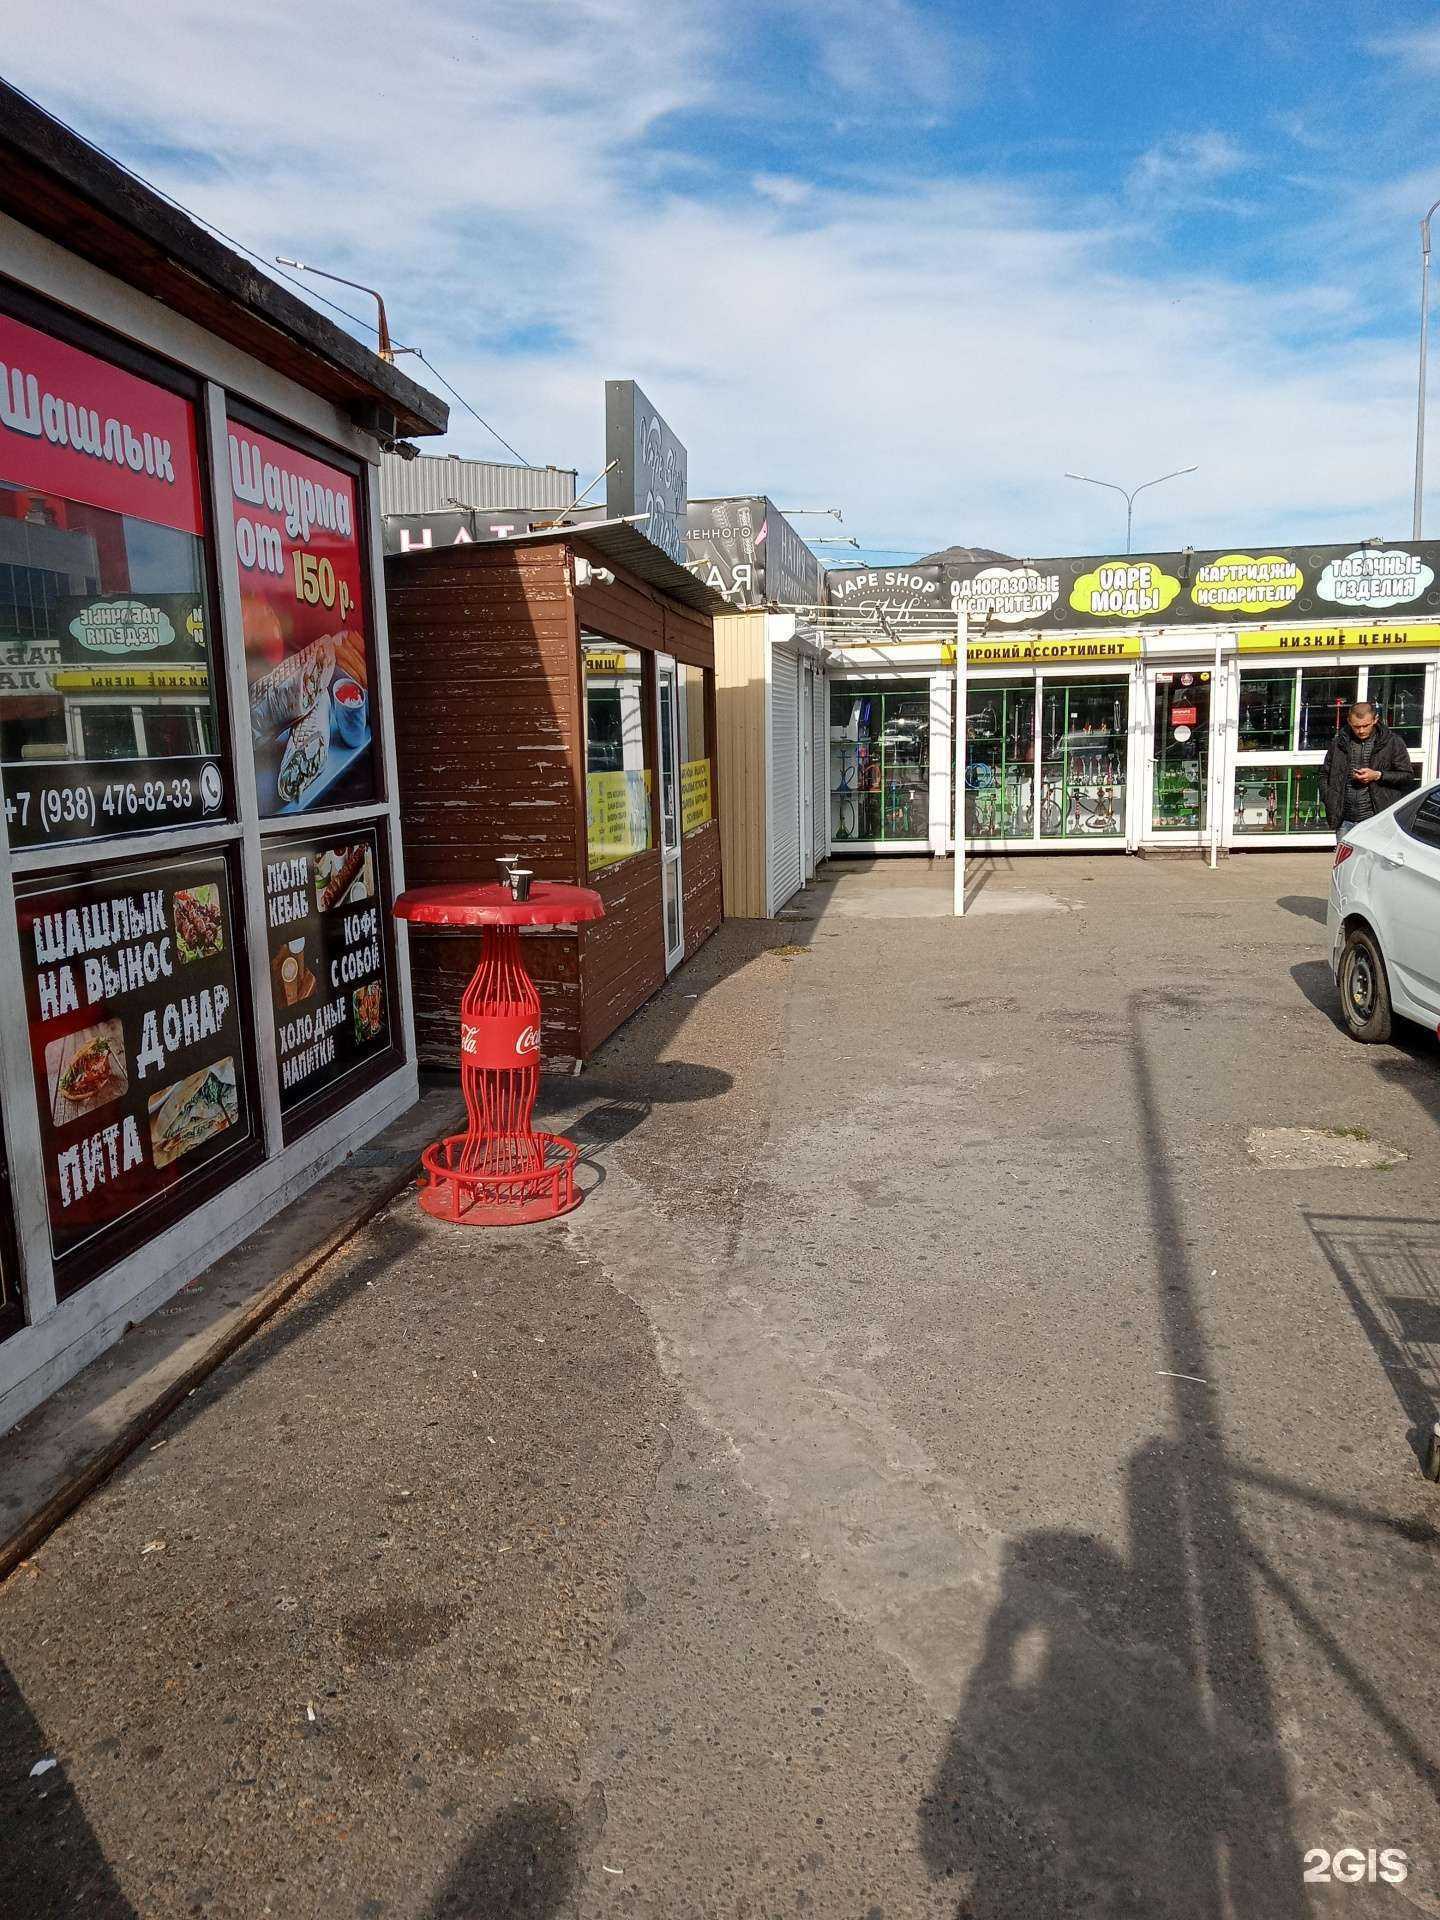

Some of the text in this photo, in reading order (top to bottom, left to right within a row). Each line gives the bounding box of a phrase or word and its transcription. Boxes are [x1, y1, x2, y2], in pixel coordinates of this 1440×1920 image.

[0, 361, 175, 484] Шашлык
[228, 435, 352, 543] Шаурма
[236, 517, 284, 574] от
[292, 550, 335, 607] 150
[690, 564, 752, 594] АЯ
[1099, 566, 1152, 590] VAPE
[1199, 562, 1297, 582] КАРТРИДЖИ
[1331, 556, 1421, 577] ТАБАЧНЫЕ
[831, 573, 879, 598] VAPE
[884, 572, 935, 593] SHOP
[950, 575, 1060, 597] ОДНОРАЗОВЫЕ
[956, 593, 1052, 615] ИСПАРИТЕЛИ
[1090, 588, 1160, 614] МОДЫ
[1197, 584, 1297, 604] ИСПАРИТЕЛИ
[1335, 576, 1415, 599] ИЗДЕЛИЯ
[1023, 643, 1125, 658] АССОРТИМЕНТ
[1279, 633, 1408, 648] НИЗКИЕ ЦЕНЫ
[4, 778, 192, 833] +7 (938) 476-82-33
[266, 856, 308, 895] ЛЮЛЯ
[32, 889, 168, 965] ШАШЛЫК
[268, 889, 310, 928] КЕБАБ
[343, 908, 378, 946] КОФЕ
[37, 936, 173, 1021] НА ВЫНОС
[331, 939, 380, 988] С СОБОЙ
[136, 984, 230, 1080] ДОНАР
[278, 996, 347, 1055] ХОЛОДНЫЕ
[282, 1035, 336, 1090] НАПИТКИ
[57, 1115, 144, 1208] ПИТА
